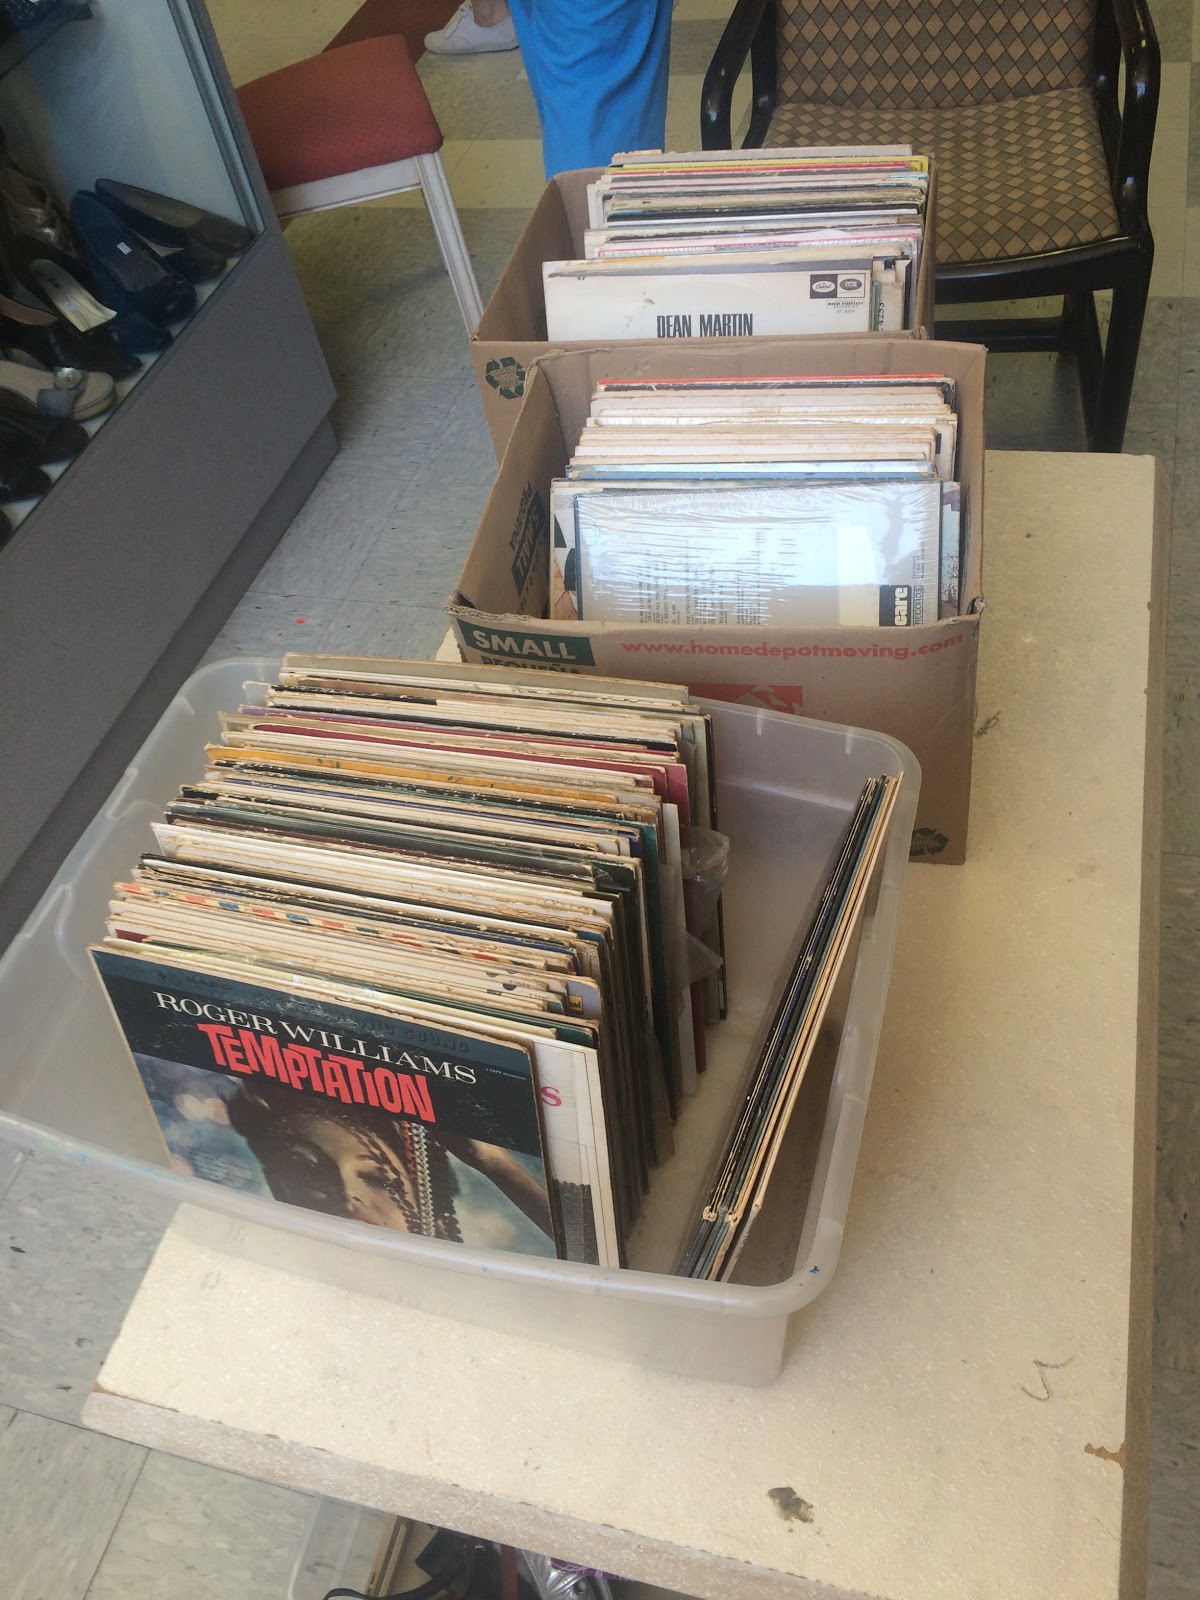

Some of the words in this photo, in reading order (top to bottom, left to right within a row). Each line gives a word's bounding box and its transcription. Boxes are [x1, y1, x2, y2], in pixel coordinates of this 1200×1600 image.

[657, 314, 691, 338] DEAN
[700, 313, 754, 337] MARTIN
[895, 587, 907, 626] care
[473, 630, 576, 660] SMALL
[620, 633, 963, 660] www.homedepotmoving.com
[152, 991, 278, 1035] ROGER
[278, 1020, 477, 1085] WILLIAMS
[197, 1022, 436, 1123] TEMPTATION
